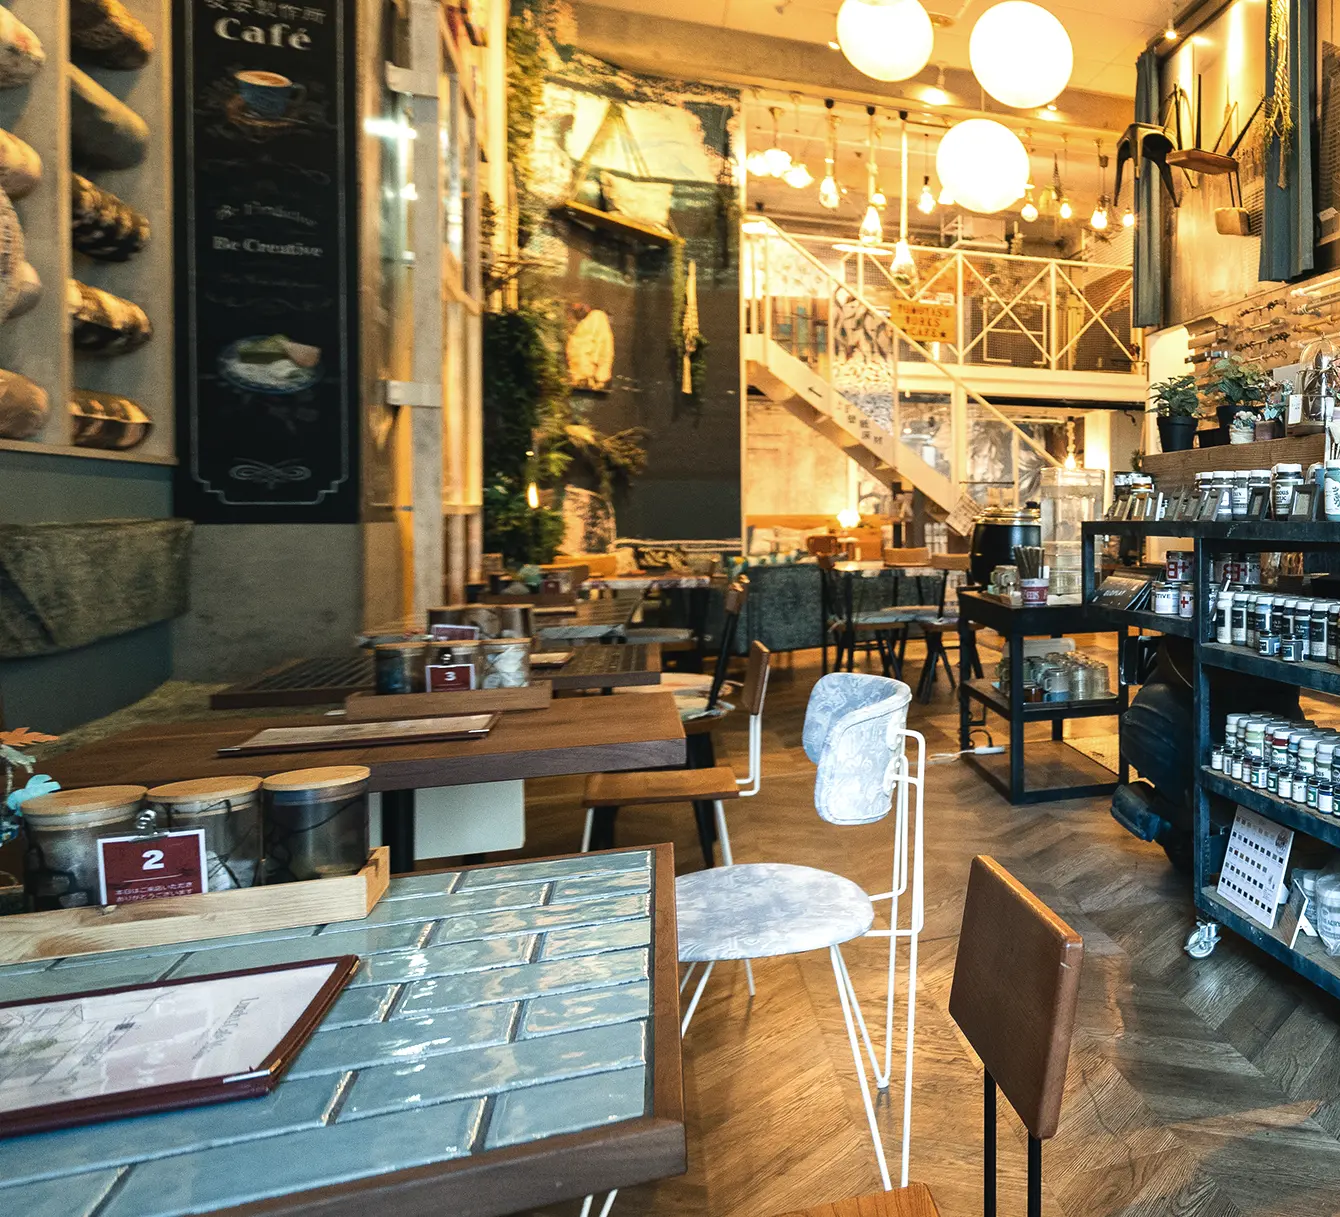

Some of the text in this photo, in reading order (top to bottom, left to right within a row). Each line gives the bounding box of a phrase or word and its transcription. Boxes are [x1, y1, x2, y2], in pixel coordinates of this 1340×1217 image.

[214, 16, 312, 50] Café
[242, 238, 324, 257] Creative
[444, 671, 457, 681] 3
[142, 849, 165, 870] 2
